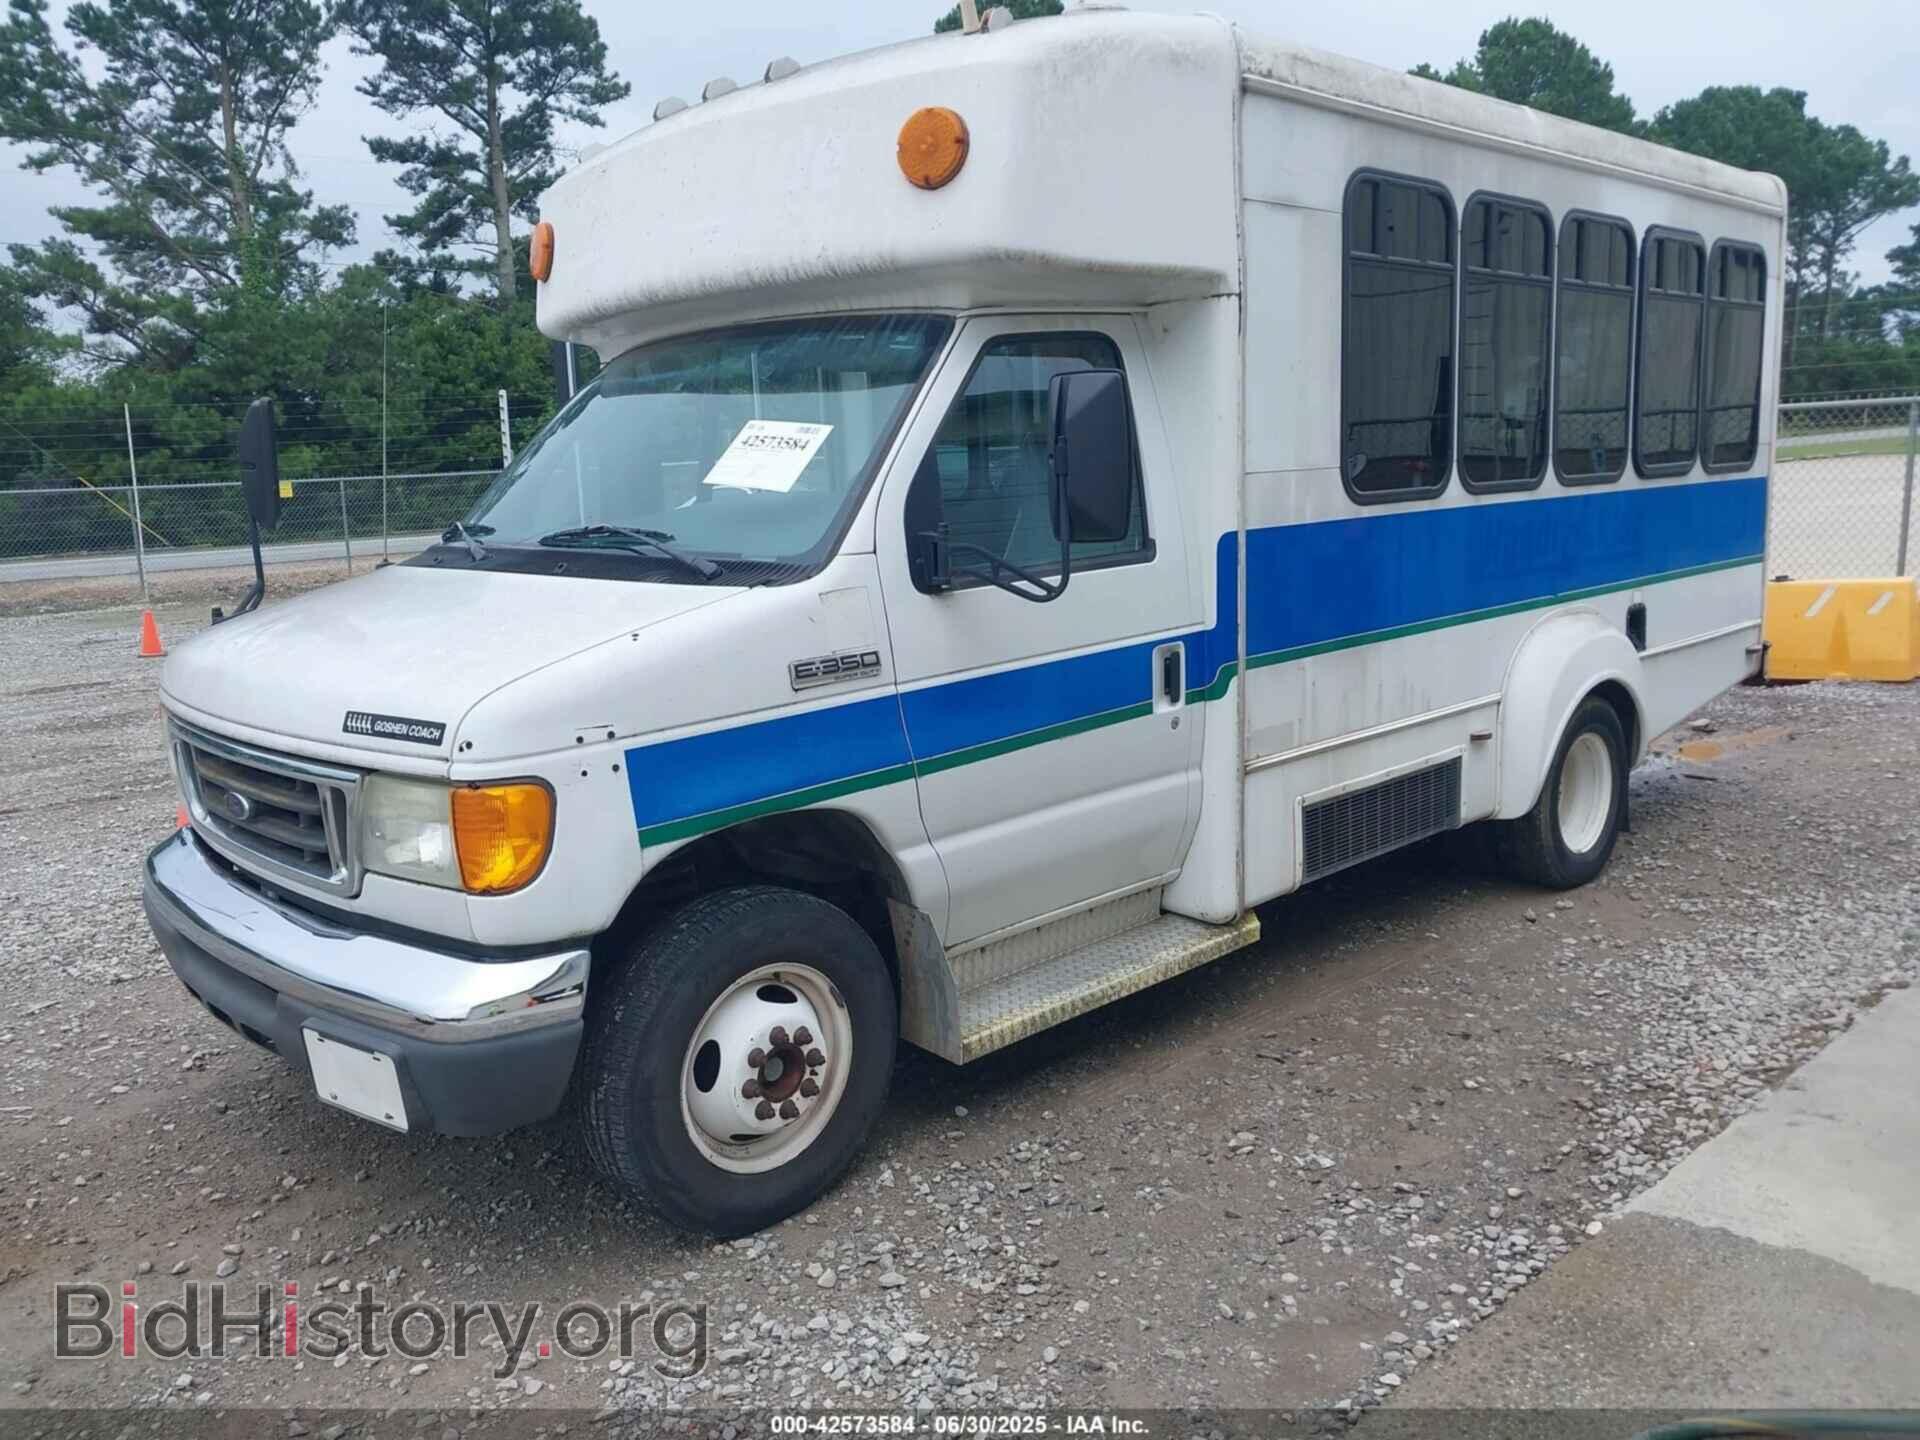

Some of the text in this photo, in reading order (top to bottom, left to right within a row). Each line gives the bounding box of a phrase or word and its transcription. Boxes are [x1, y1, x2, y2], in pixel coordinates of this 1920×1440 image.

[741, 434, 810, 451] 42573584
[374, 720, 441, 739] GOSHEN COACH
